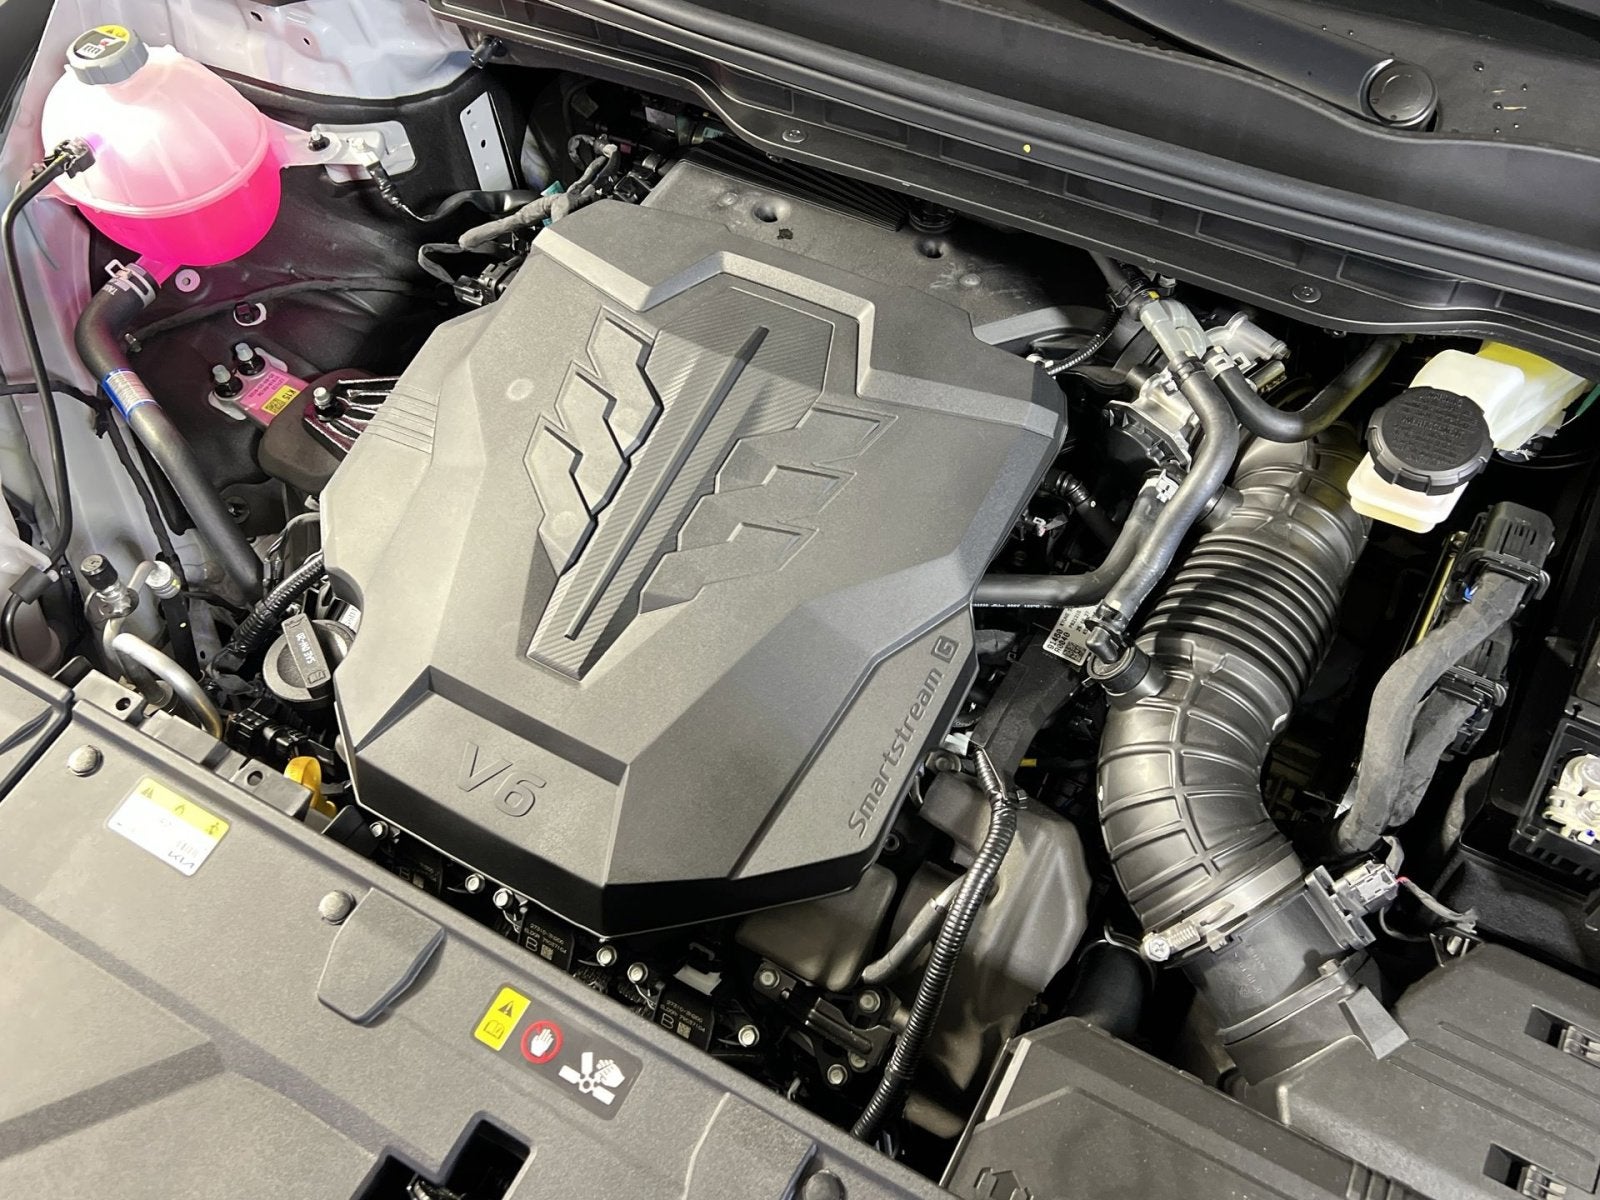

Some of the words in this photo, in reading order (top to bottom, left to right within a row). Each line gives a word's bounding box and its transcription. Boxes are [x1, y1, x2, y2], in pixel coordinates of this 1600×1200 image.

[303, 650, 316, 664] SAE
[848, 667, 945, 839] Smartstream
[932, 636, 959, 664] G
[457, 741, 547, 817] V6
[168, 851, 195, 869] KIA
[526, 936, 538, 952] B
[661, 1013, 674, 1029] B
